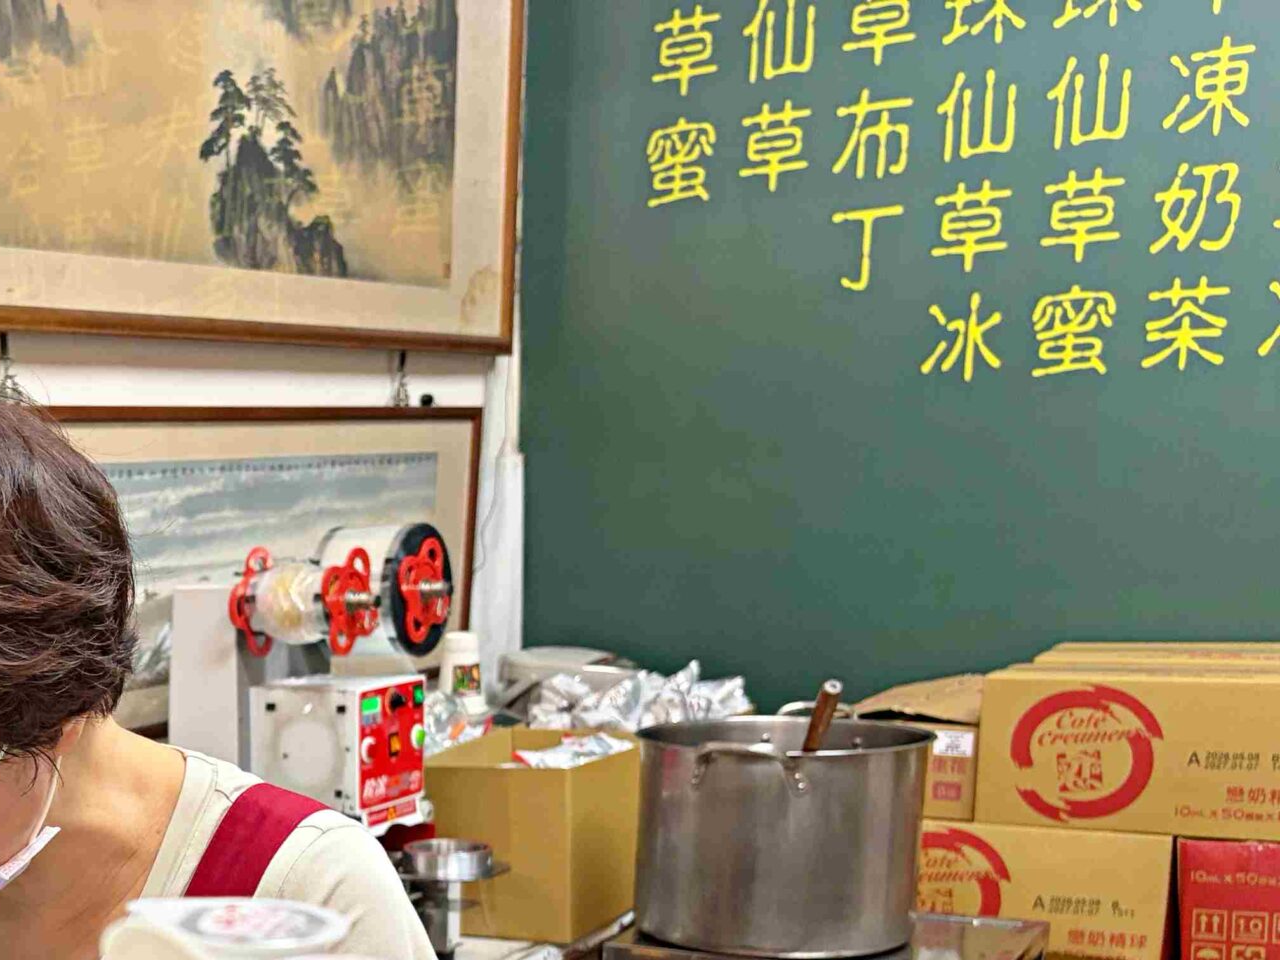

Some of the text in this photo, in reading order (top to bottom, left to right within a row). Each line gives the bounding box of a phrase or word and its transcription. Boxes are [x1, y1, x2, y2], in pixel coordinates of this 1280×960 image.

[646, 4, 721, 208] 草蜜
[740, 0, 815, 191] 仙草
[1140, 0, 1257, 370] 凍奶茶
[1187, 751, 1200, 768] A
[1032, 894, 1045, 911] A
